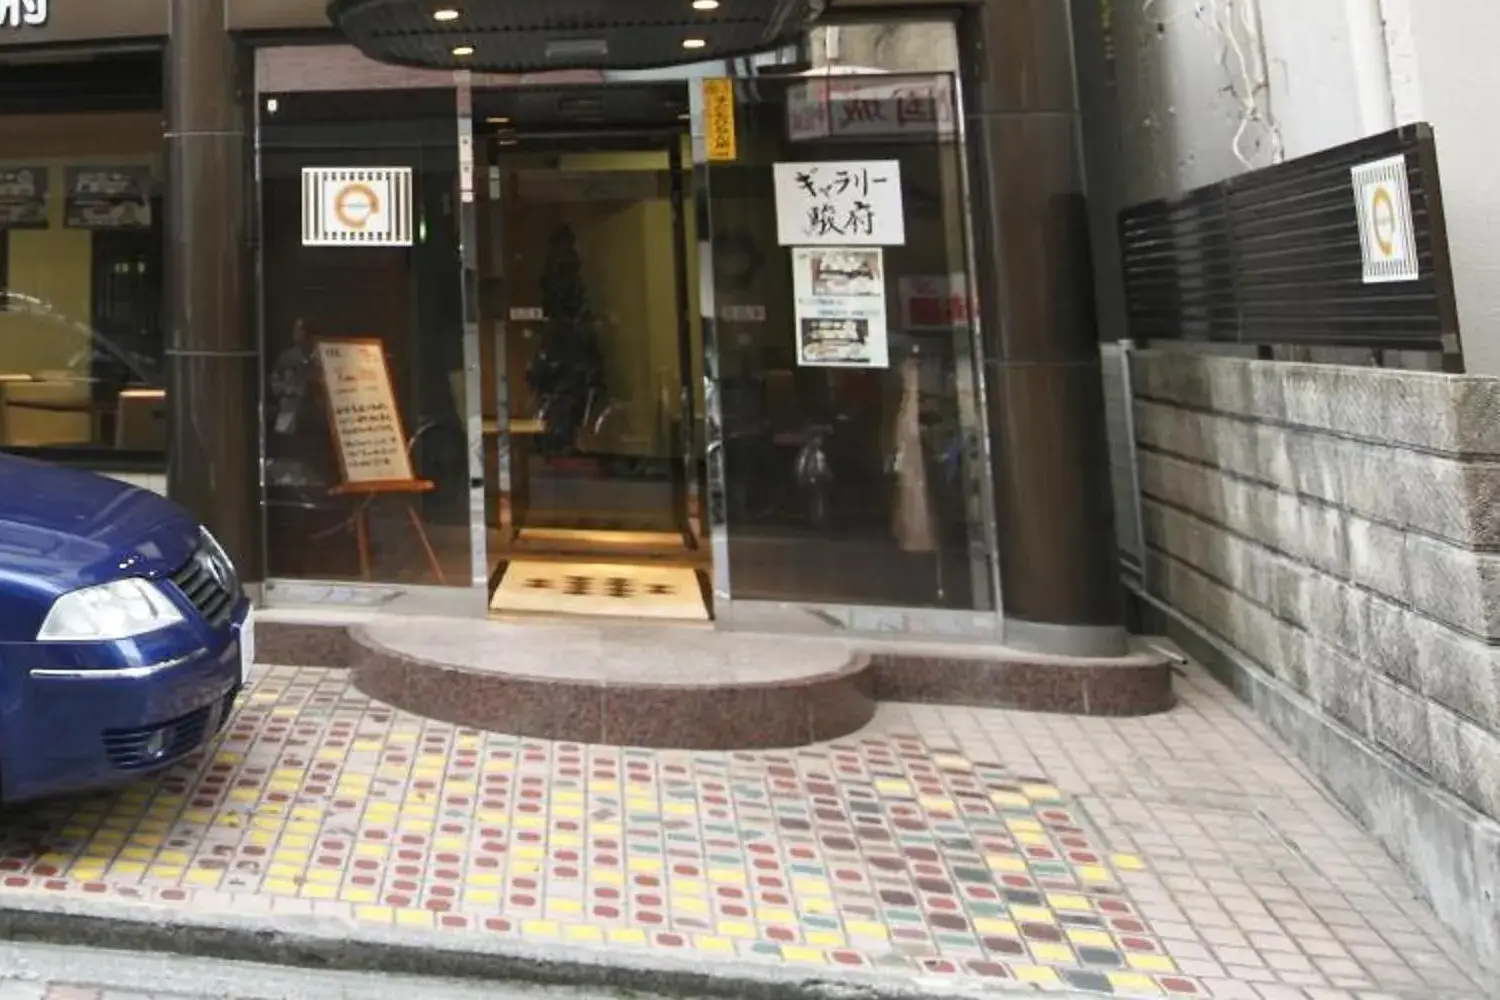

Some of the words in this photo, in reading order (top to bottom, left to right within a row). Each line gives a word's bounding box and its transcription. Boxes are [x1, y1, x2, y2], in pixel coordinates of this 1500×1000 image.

[794, 167, 888, 198] ギャラリー
[803, 200, 874, 236] 駿府
